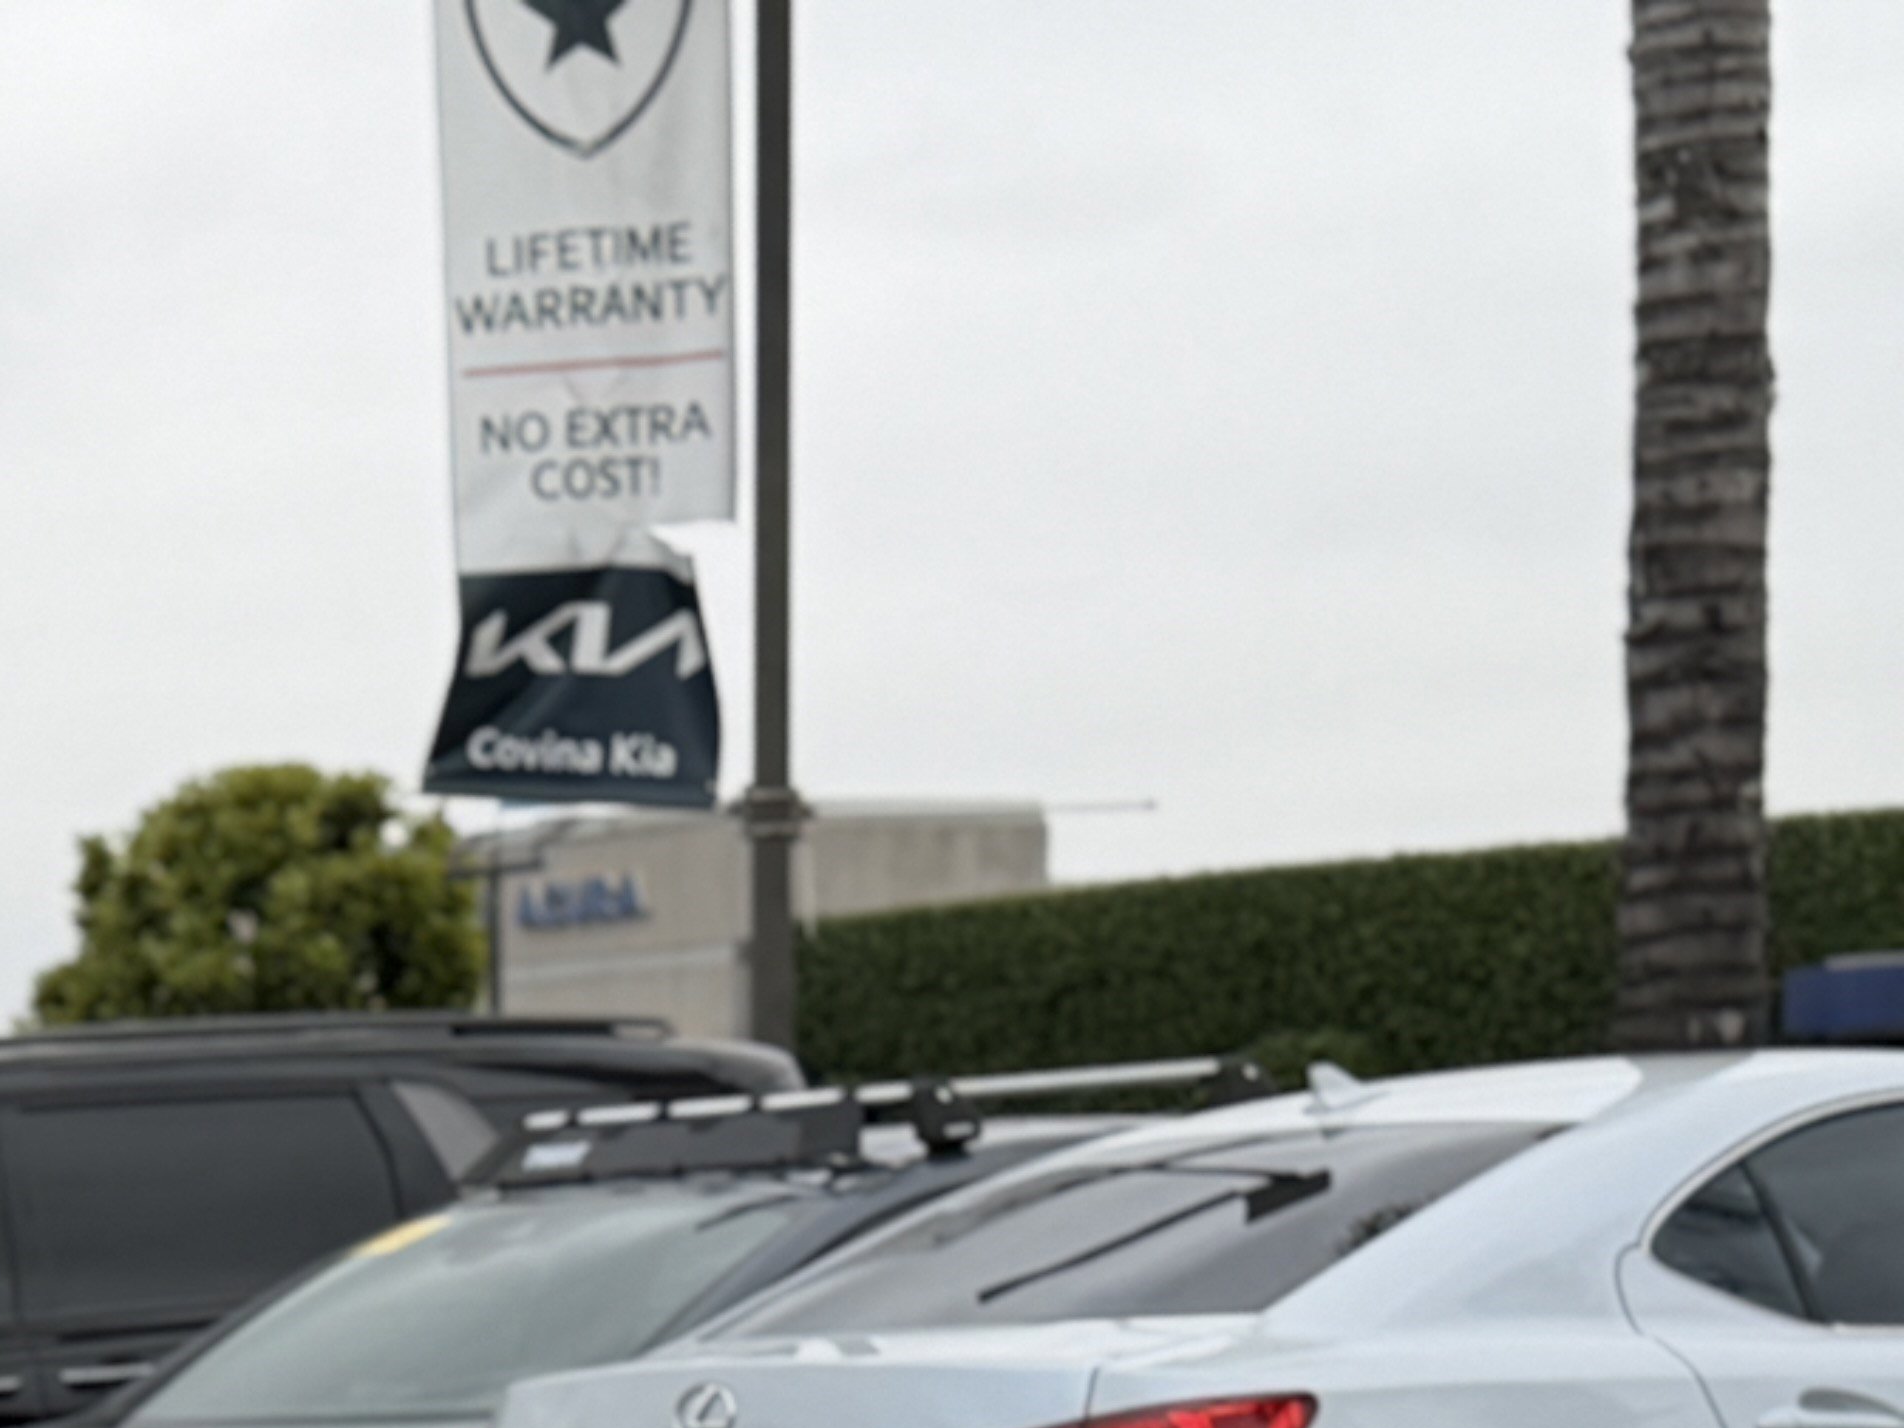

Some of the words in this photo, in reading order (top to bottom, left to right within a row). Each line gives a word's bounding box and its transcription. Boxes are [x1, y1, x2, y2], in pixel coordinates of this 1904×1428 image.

[486, 222, 694, 279] LIFETIME
[455, 277, 728, 337] WARRANTY
[479, 410, 550, 455] NO
[567, 400, 713, 448] EXTRA
[530, 457, 661, 503] COST!
[466, 725, 605, 777] Covina
[610, 727, 678, 780] Kia
